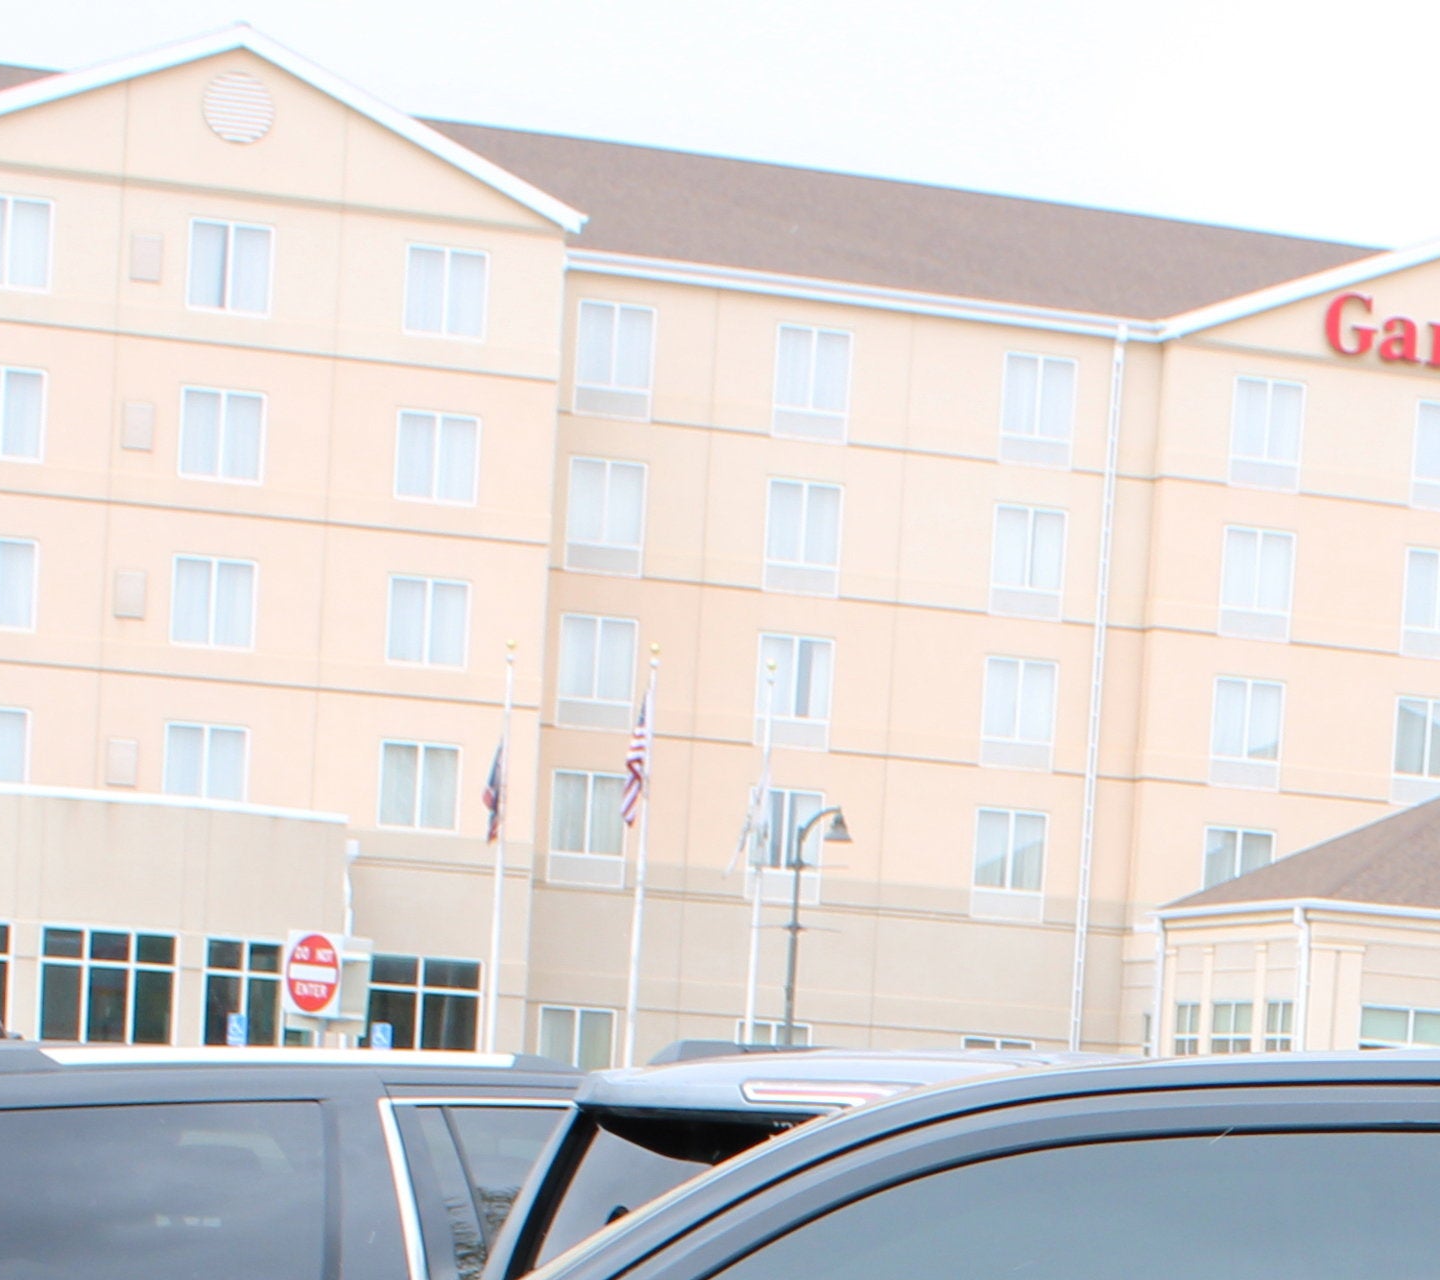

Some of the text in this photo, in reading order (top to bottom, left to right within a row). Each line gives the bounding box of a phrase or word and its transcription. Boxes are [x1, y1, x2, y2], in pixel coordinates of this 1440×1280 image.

[294, 945, 334, 963] DO NOT
[294, 981, 328, 998] ENTER
